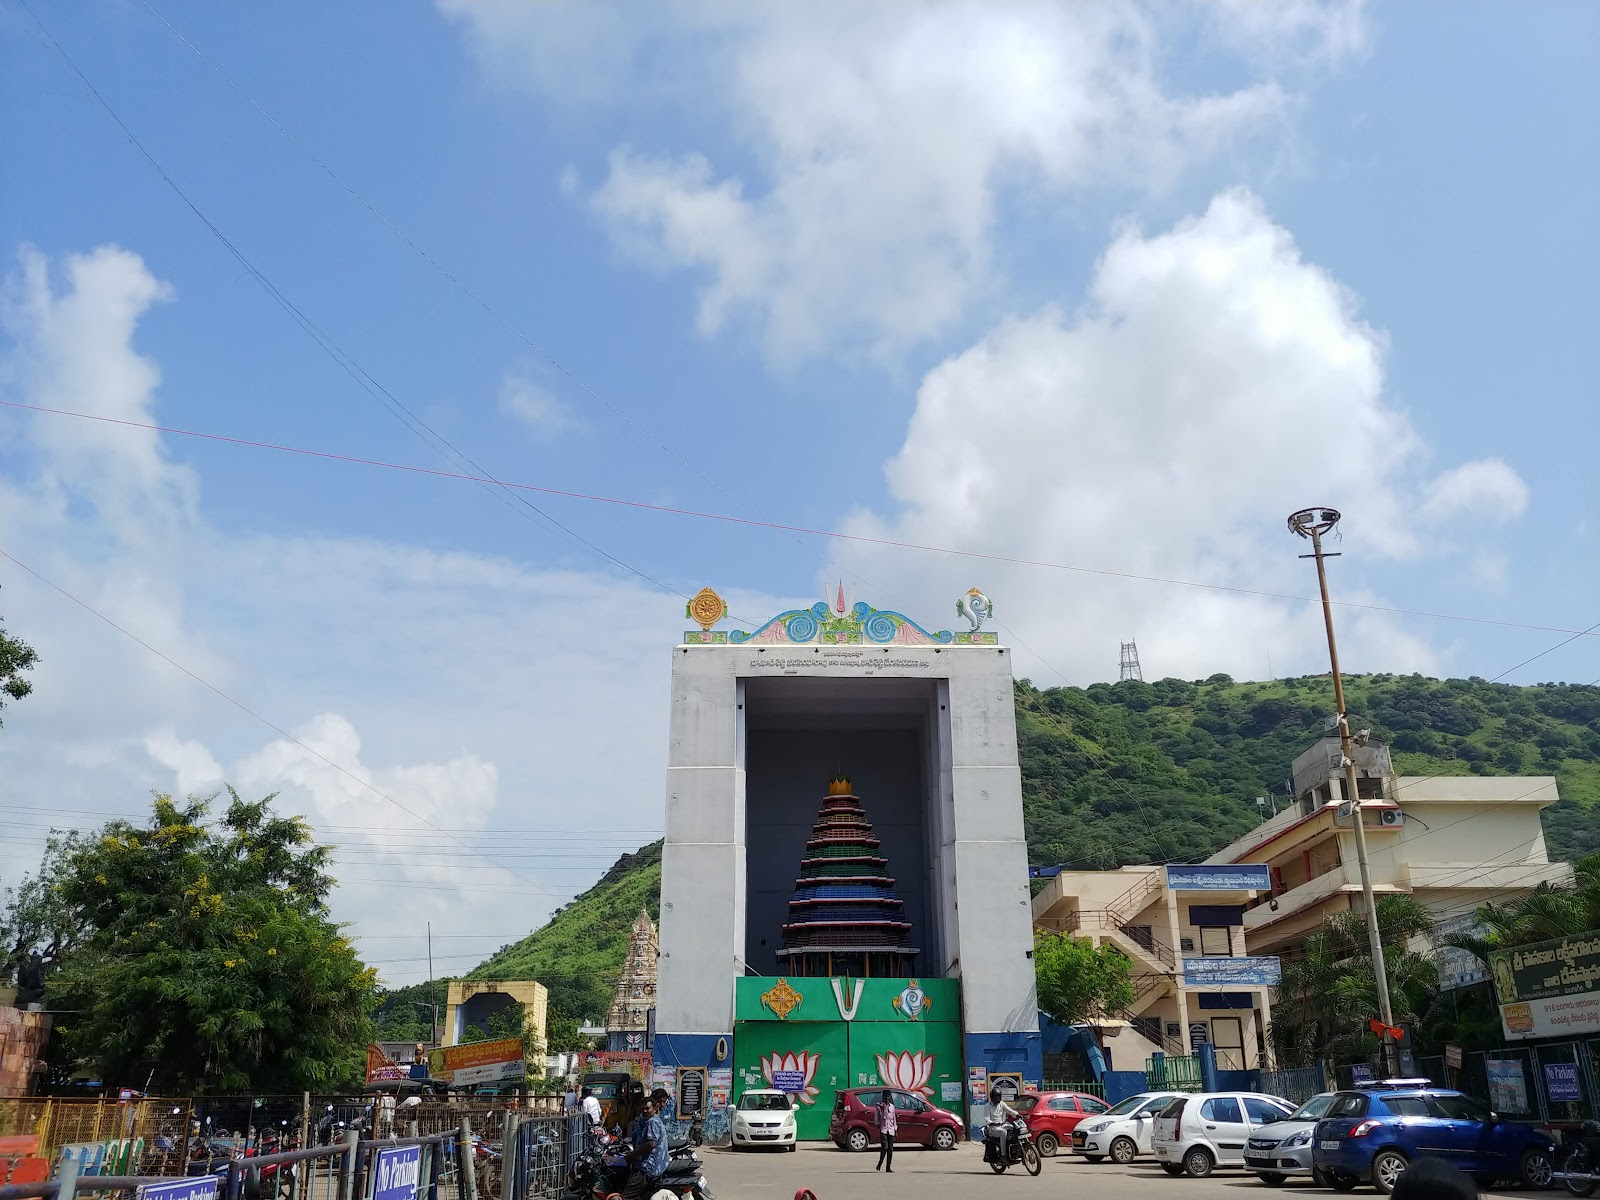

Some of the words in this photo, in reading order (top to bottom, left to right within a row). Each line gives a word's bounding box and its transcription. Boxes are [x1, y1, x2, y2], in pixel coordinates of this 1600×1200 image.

[1544, 1004, 1556, 1013] 916
[1545, 1067, 1555, 1080] No
[1554, 1065, 1576, 1084] Parking
[377, 1158, 390, 1193] No
[389, 1152, 418, 1194] Parking
